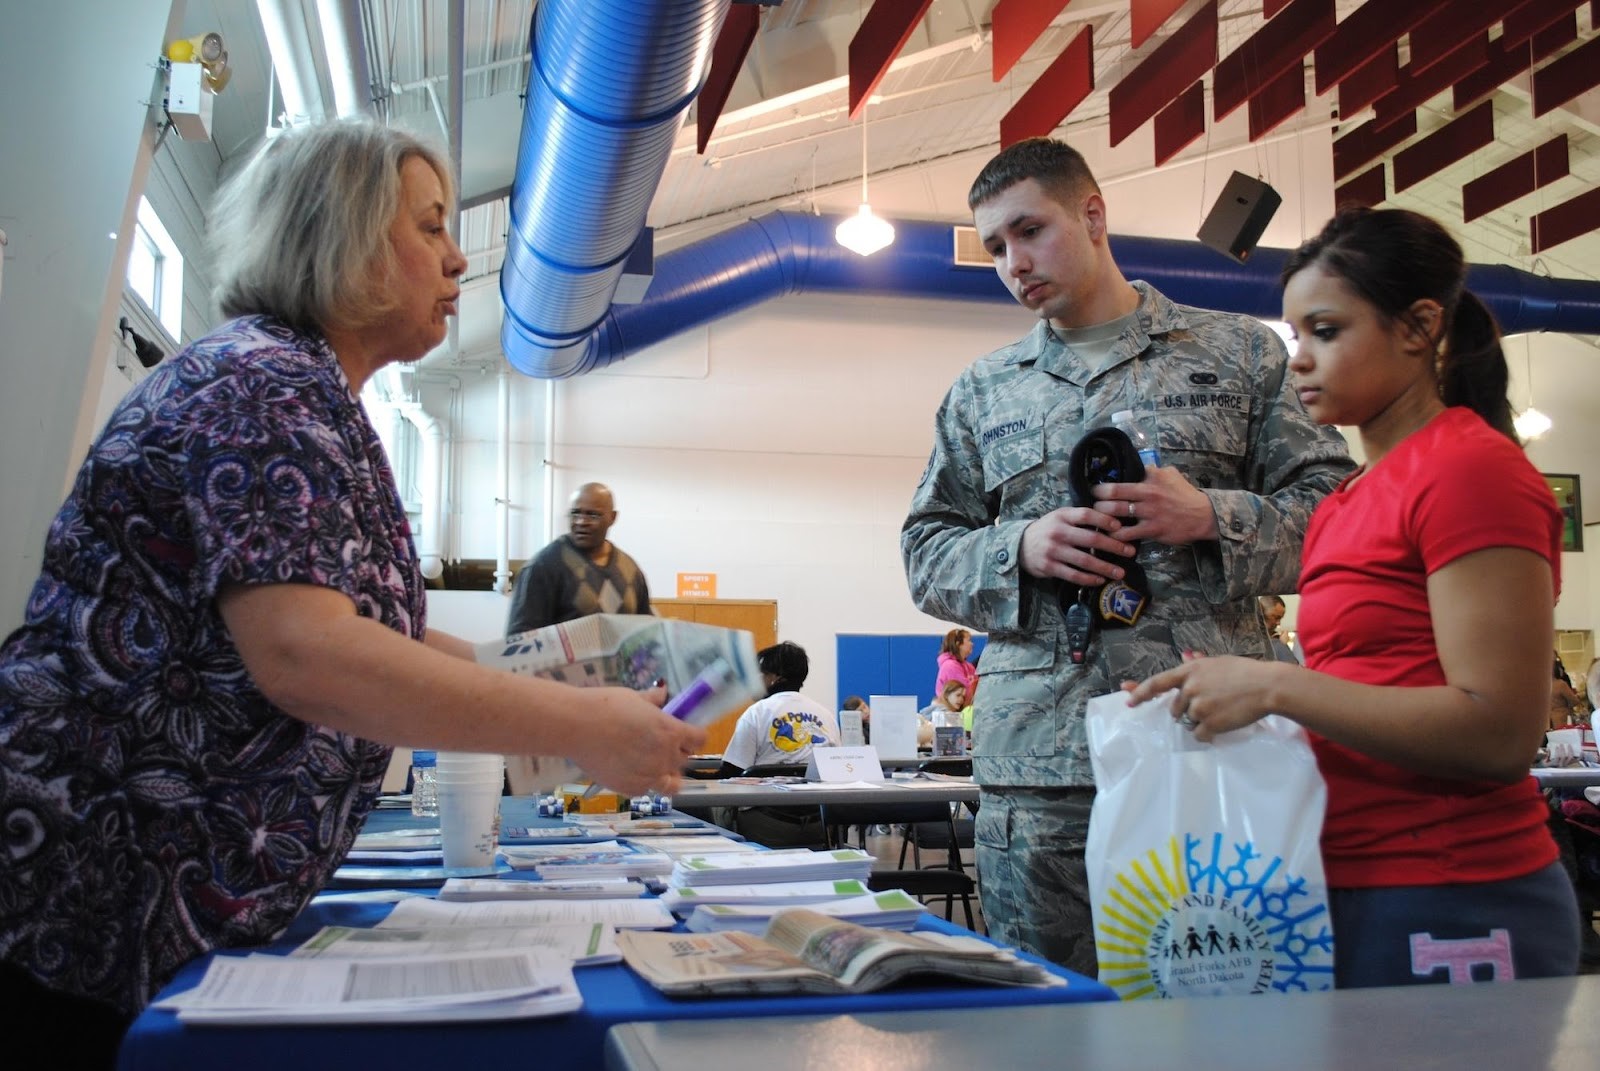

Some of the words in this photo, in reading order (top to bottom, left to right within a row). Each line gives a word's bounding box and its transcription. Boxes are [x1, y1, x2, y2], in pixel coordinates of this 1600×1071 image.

[1163, 395, 1187, 409] U.S.
[1190, 394, 1208, 408] AIR
[1211, 394, 1243, 410] FORCE
[683, 575, 709, 583] SPORTS
[682, 590, 711, 598] FITNESS
[1219, 897, 1272, 952] FAMILY
[1198, 961, 1227, 972] Forks
[1228, 957, 1252, 969] AFB
[1176, 975, 1205, 987] North
[1208, 971, 1245, 984] Dakota
